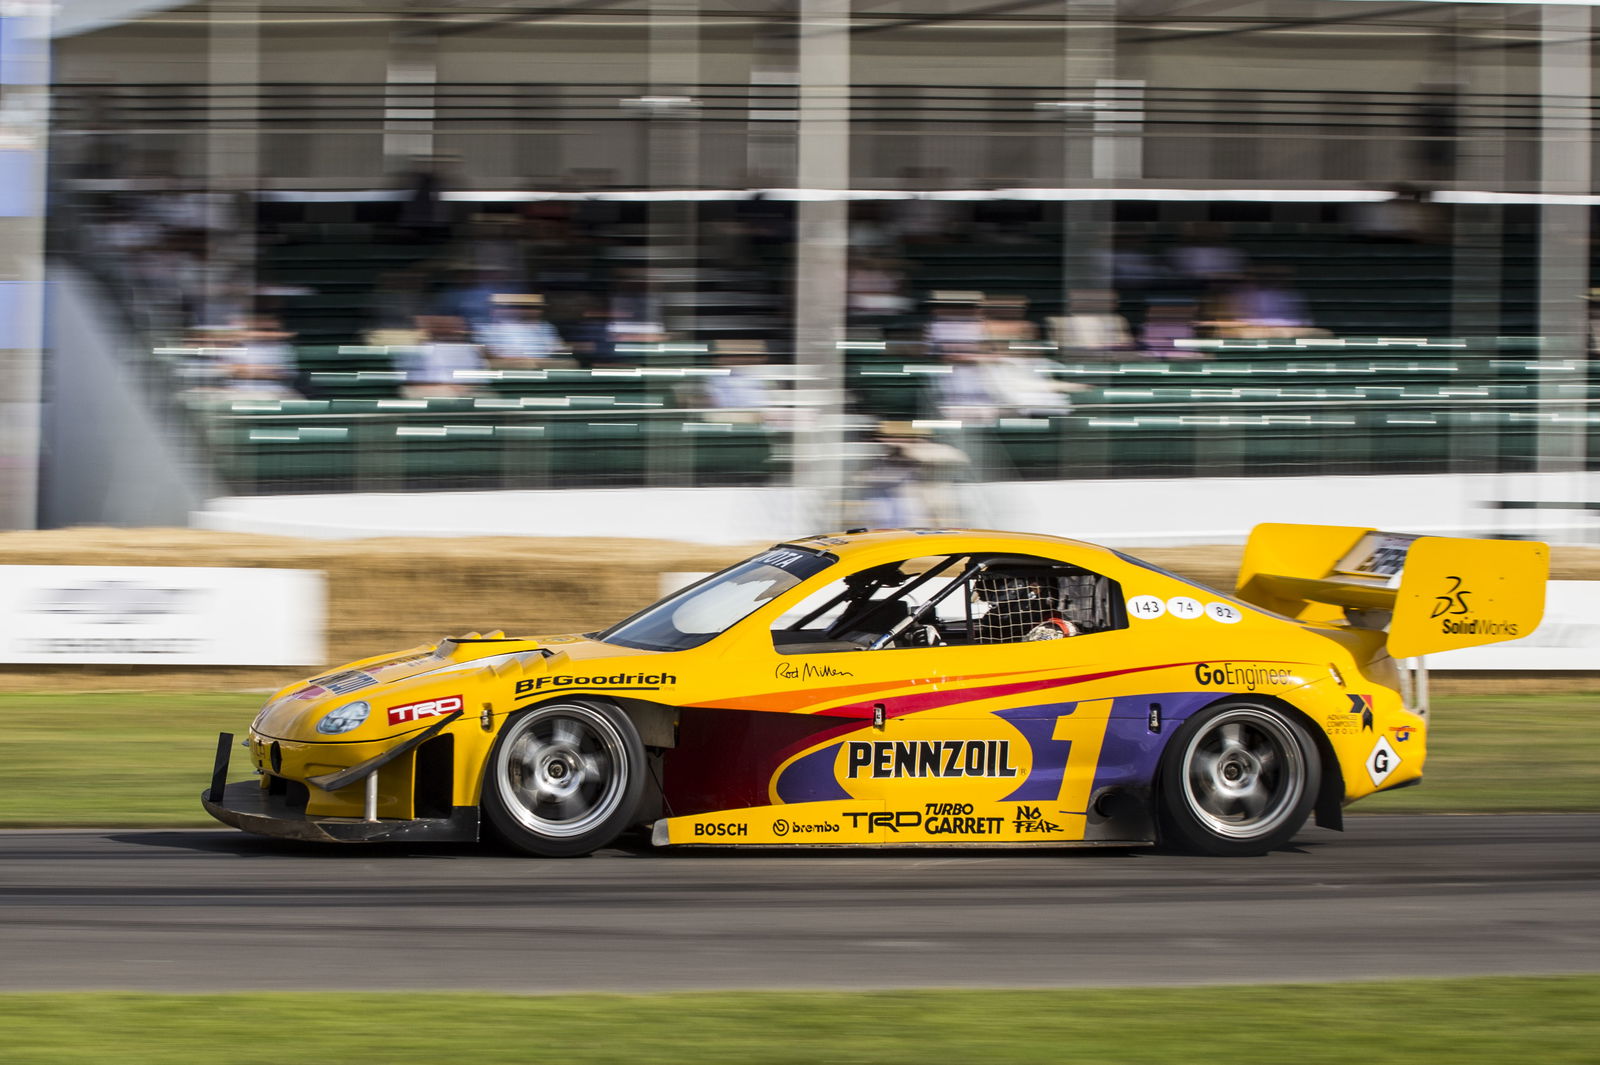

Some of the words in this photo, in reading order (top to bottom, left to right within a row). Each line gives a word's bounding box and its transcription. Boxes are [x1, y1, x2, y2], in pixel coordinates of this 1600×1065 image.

[1135, 601, 1159, 613] 143
[1176, 602, 1194, 613] 74
[1216, 606, 1233, 619] 82
[1442, 619, 1519, 636] SolidWorks
[775, 662, 799, 679] Rod
[1195, 663, 1293, 691] GoEngineer
[515, 673, 677, 694] BFGoodrich
[389, 697, 462, 721] TRD
[845, 740, 1018, 779] PENNZOIL
[1051, 698, 1114, 806] 1
[1374, 749, 1388, 774] G
[925, 803, 974, 816] TURBO
[694, 823, 748, 836] BOSCH
[792, 821, 840, 833] brembo
[842, 811, 922, 834] TRD
[925, 817, 1004, 835] GARRETT
[1012, 818, 1064, 834] FEAR
